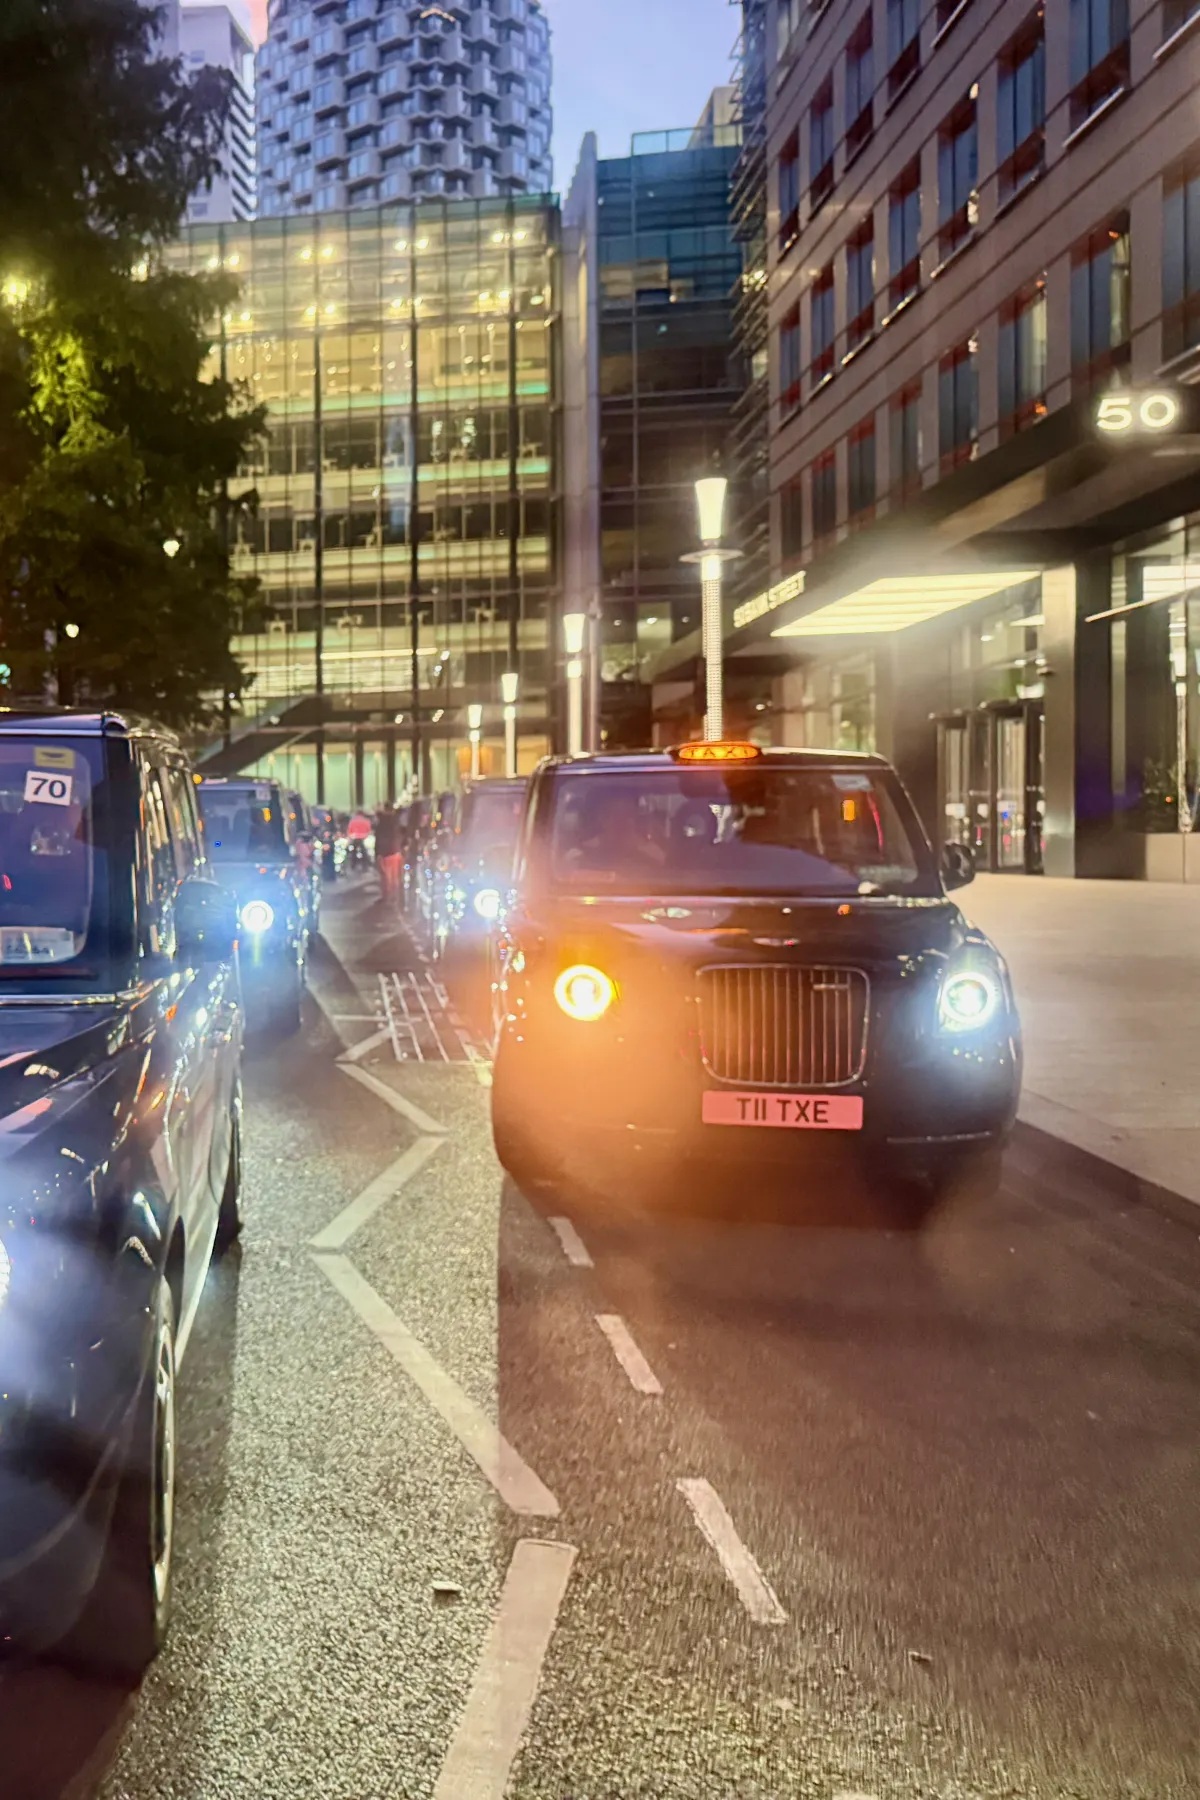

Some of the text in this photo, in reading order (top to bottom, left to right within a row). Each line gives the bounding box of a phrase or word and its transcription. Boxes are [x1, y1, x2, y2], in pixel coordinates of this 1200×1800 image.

[1096, 394, 1175, 431] 50
[688, 746, 749, 758] TAXI
[30, 776, 67, 799] 70
[776, 1099, 829, 1123] TXE
